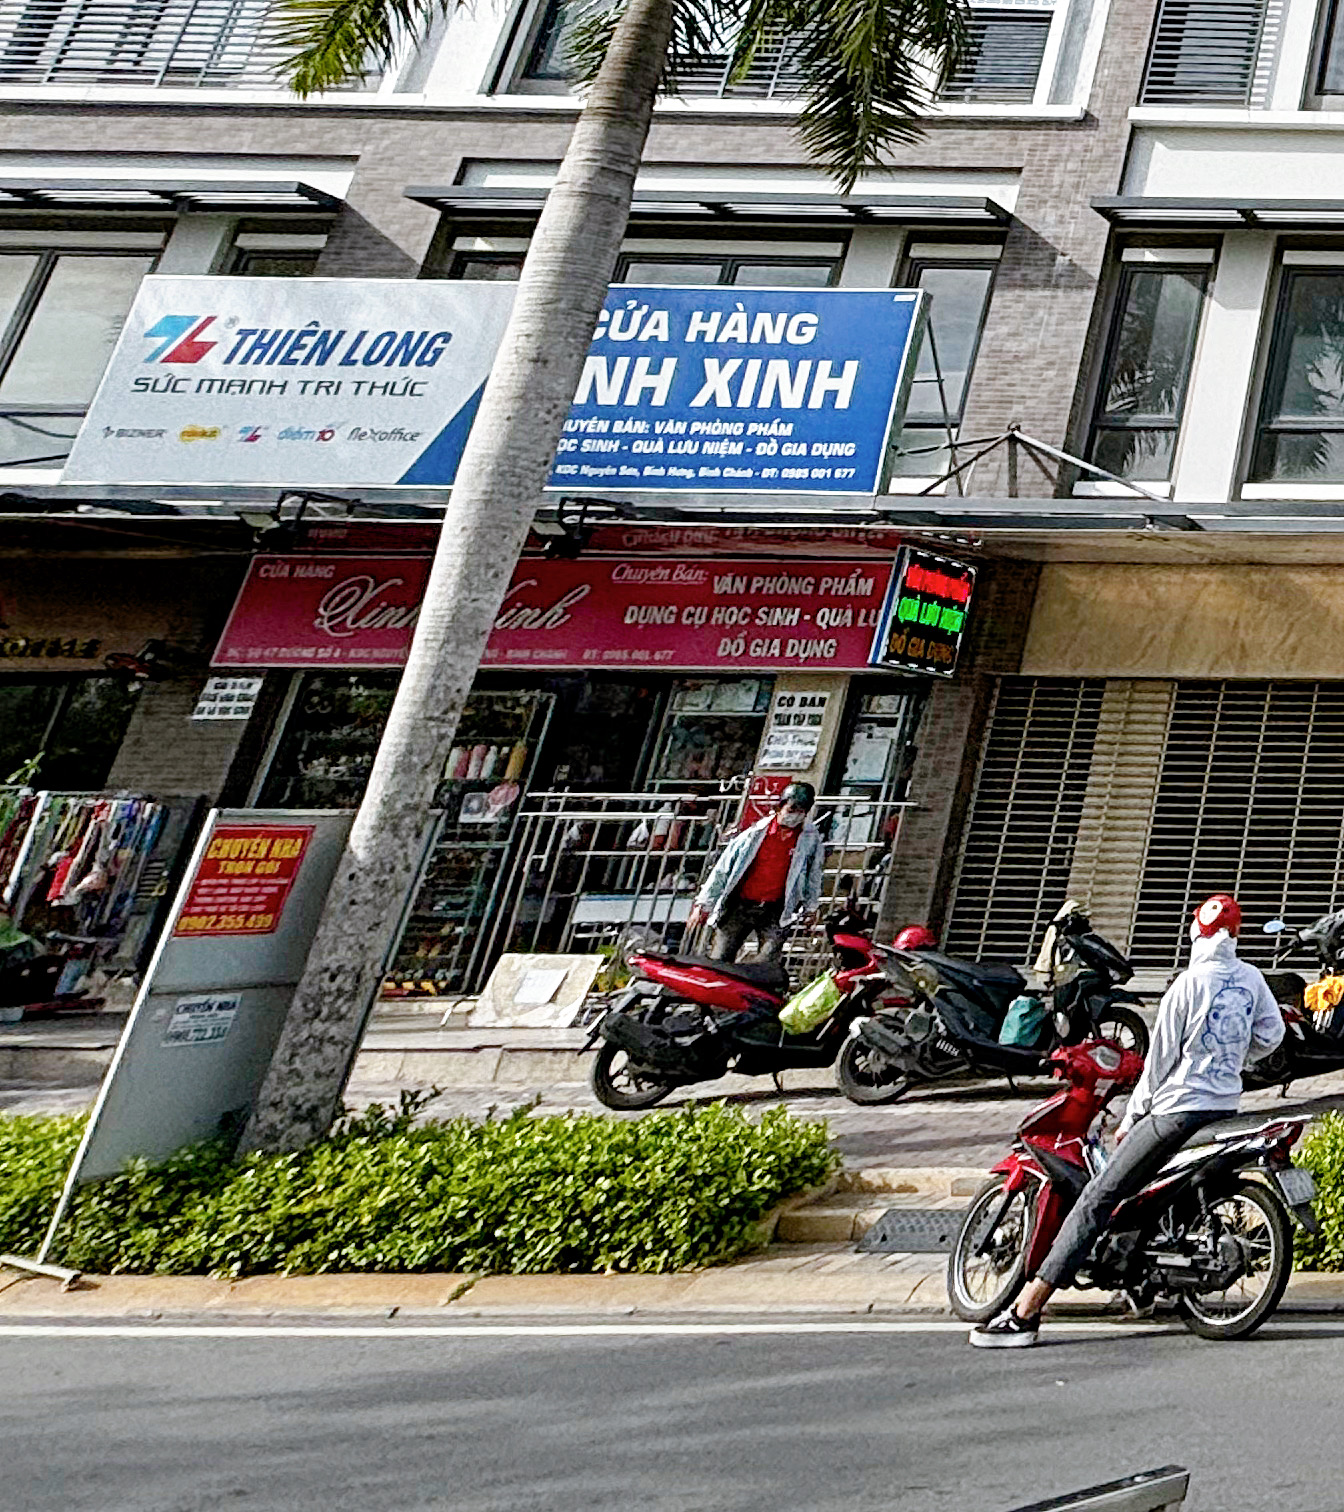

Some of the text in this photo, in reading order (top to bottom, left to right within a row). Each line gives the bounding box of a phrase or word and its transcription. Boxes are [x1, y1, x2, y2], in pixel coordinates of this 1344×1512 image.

[685, 302, 818, 345] HÀNG
[223, 320, 453, 368] THIÊN LONG
[130, 374, 191, 394] SỨC
[300, 380, 342, 396] TRI
[352, 376, 429, 397] THỨC
[690, 359, 859, 409] XINH
[654, 418, 688, 434] VĂN
[580, 439, 620, 453] SINH
[781, 442, 807, 456] GIA
[811, 442, 856, 459] DỤNG
[713, 568, 875, 597] VĂN PHÒNG PHẨM
[313, 575, 592, 638] Xin inh
[624, 605, 677, 629] DỤNG
[681, 605, 707, 629] CỤ
[711, 605, 750, 628] HỌC
[754, 606, 801, 626] SINH
[815, 603, 853, 629] QUÀ
[717, 632, 837, 663] ĐỒ GIA DỤNG
